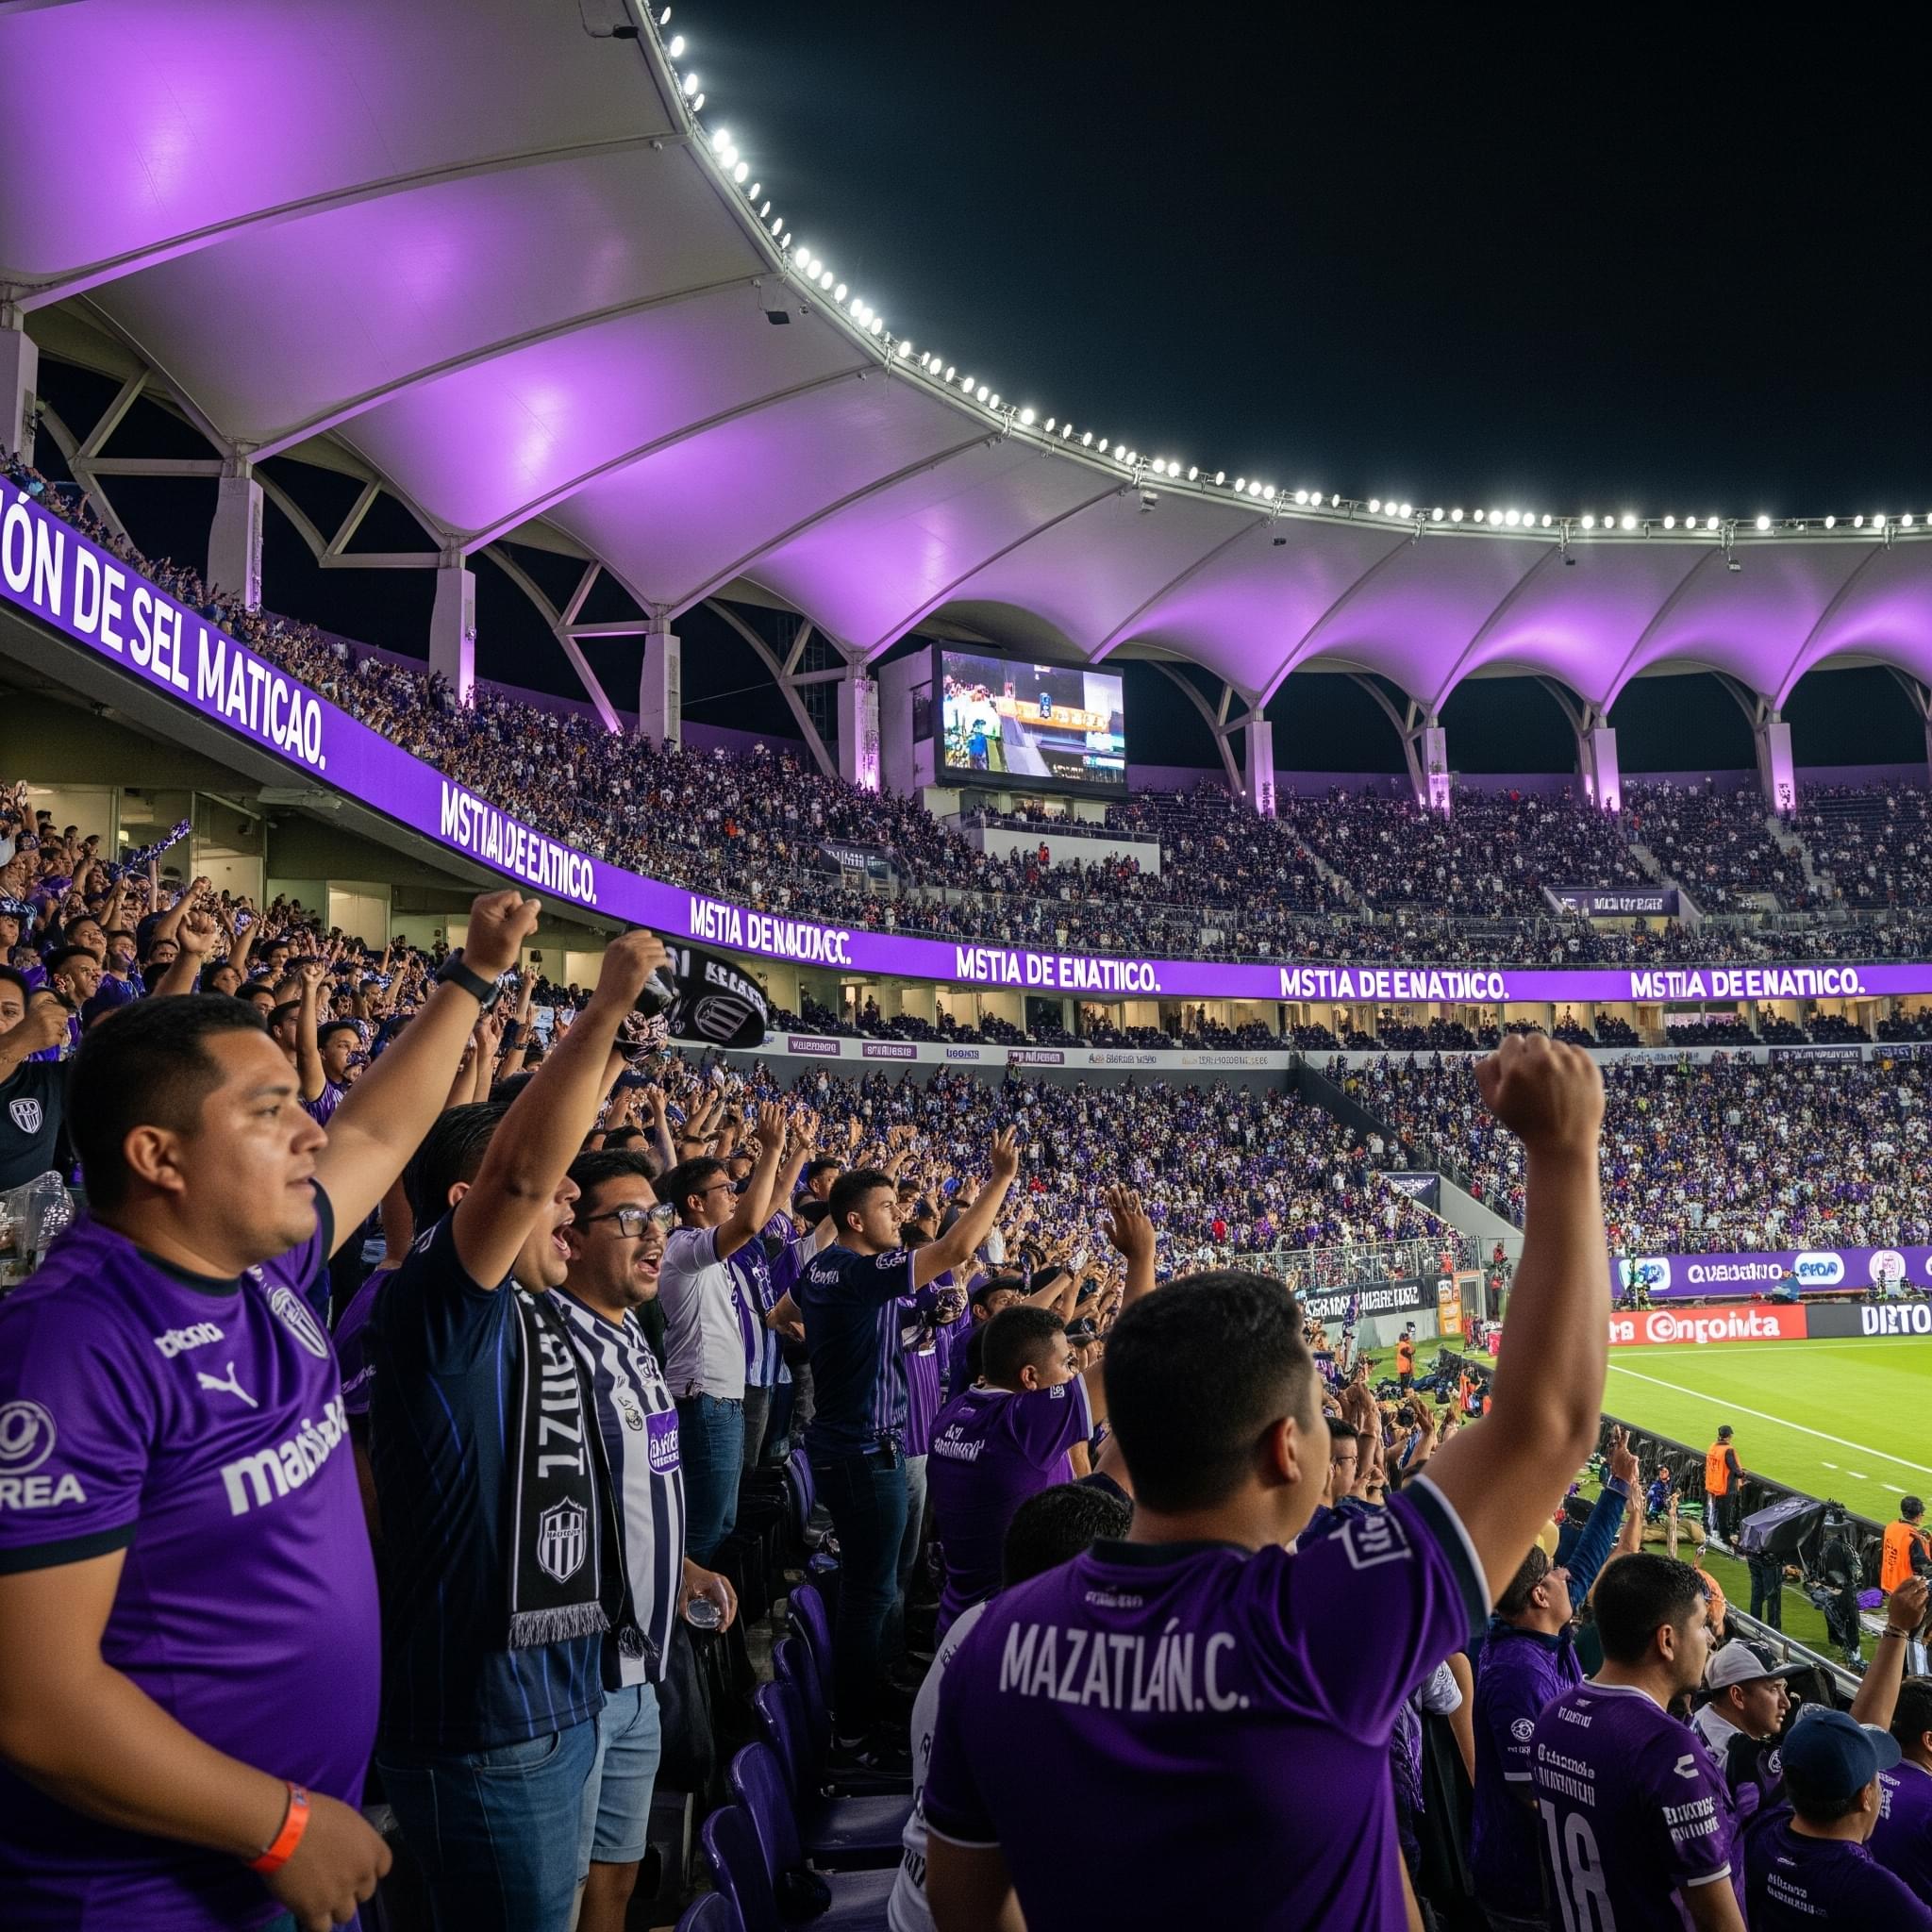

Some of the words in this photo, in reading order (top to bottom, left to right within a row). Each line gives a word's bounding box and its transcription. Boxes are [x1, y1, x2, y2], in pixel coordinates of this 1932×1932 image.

[0, 489, 65, 617] ÓN
[74, 545, 125, 653] DE
[129, 587, 190, 692] SEL
[1026, 954, 1055, 986] DE
[1280, 968, 1356, 998] MSTIA
